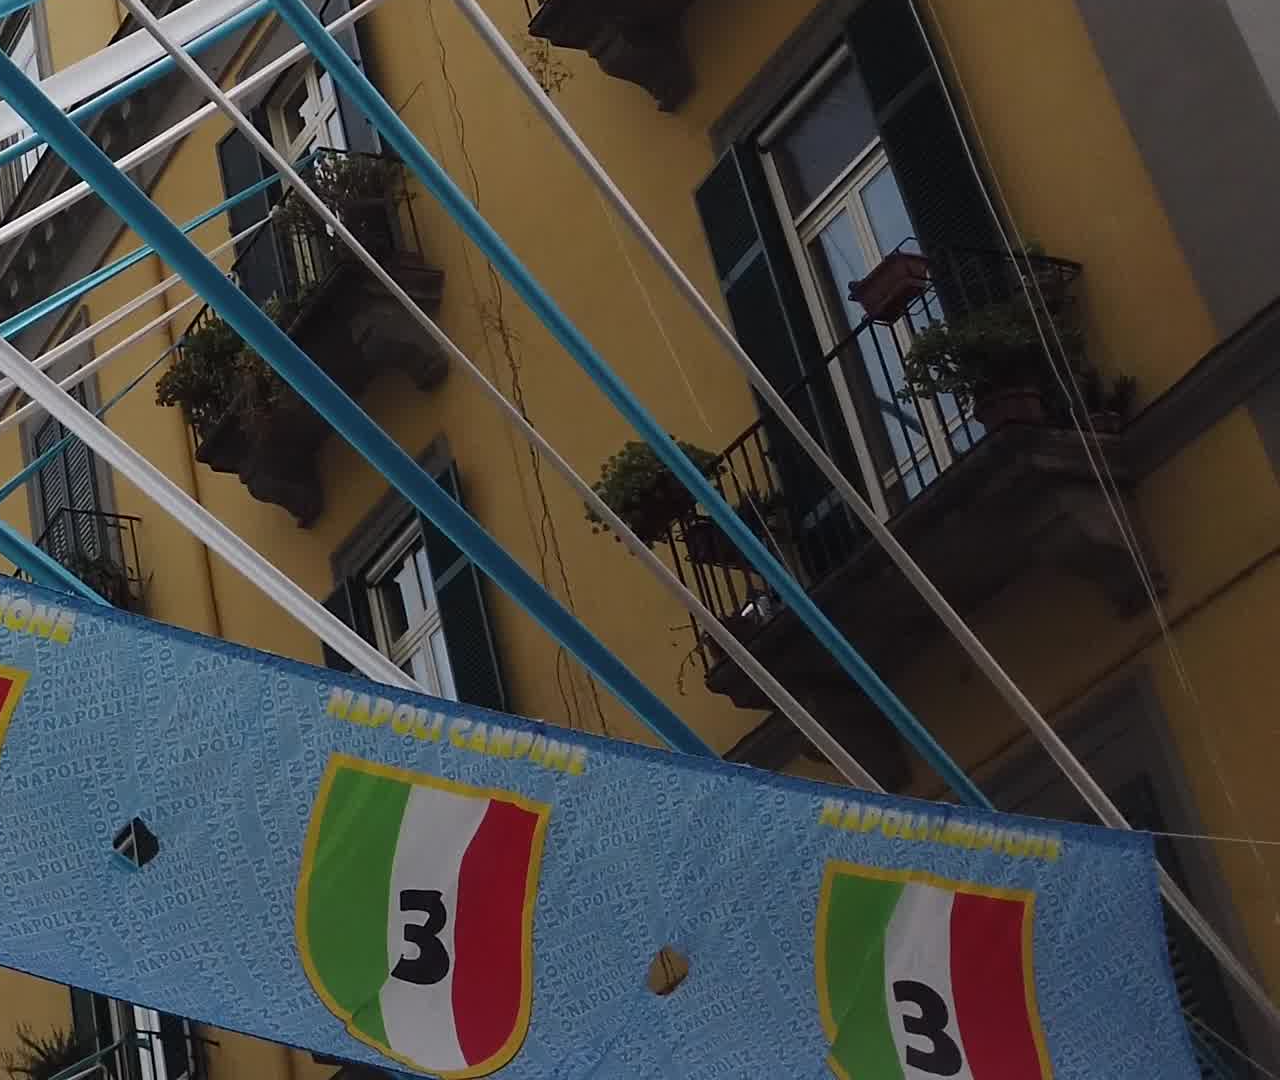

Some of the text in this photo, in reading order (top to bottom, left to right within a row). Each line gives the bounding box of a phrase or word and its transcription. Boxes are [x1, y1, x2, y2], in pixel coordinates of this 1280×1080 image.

[327, 687, 443, 744] NAPOLI
[389, 888, 451, 986] 3
[892, 979, 963, 1077] 3
